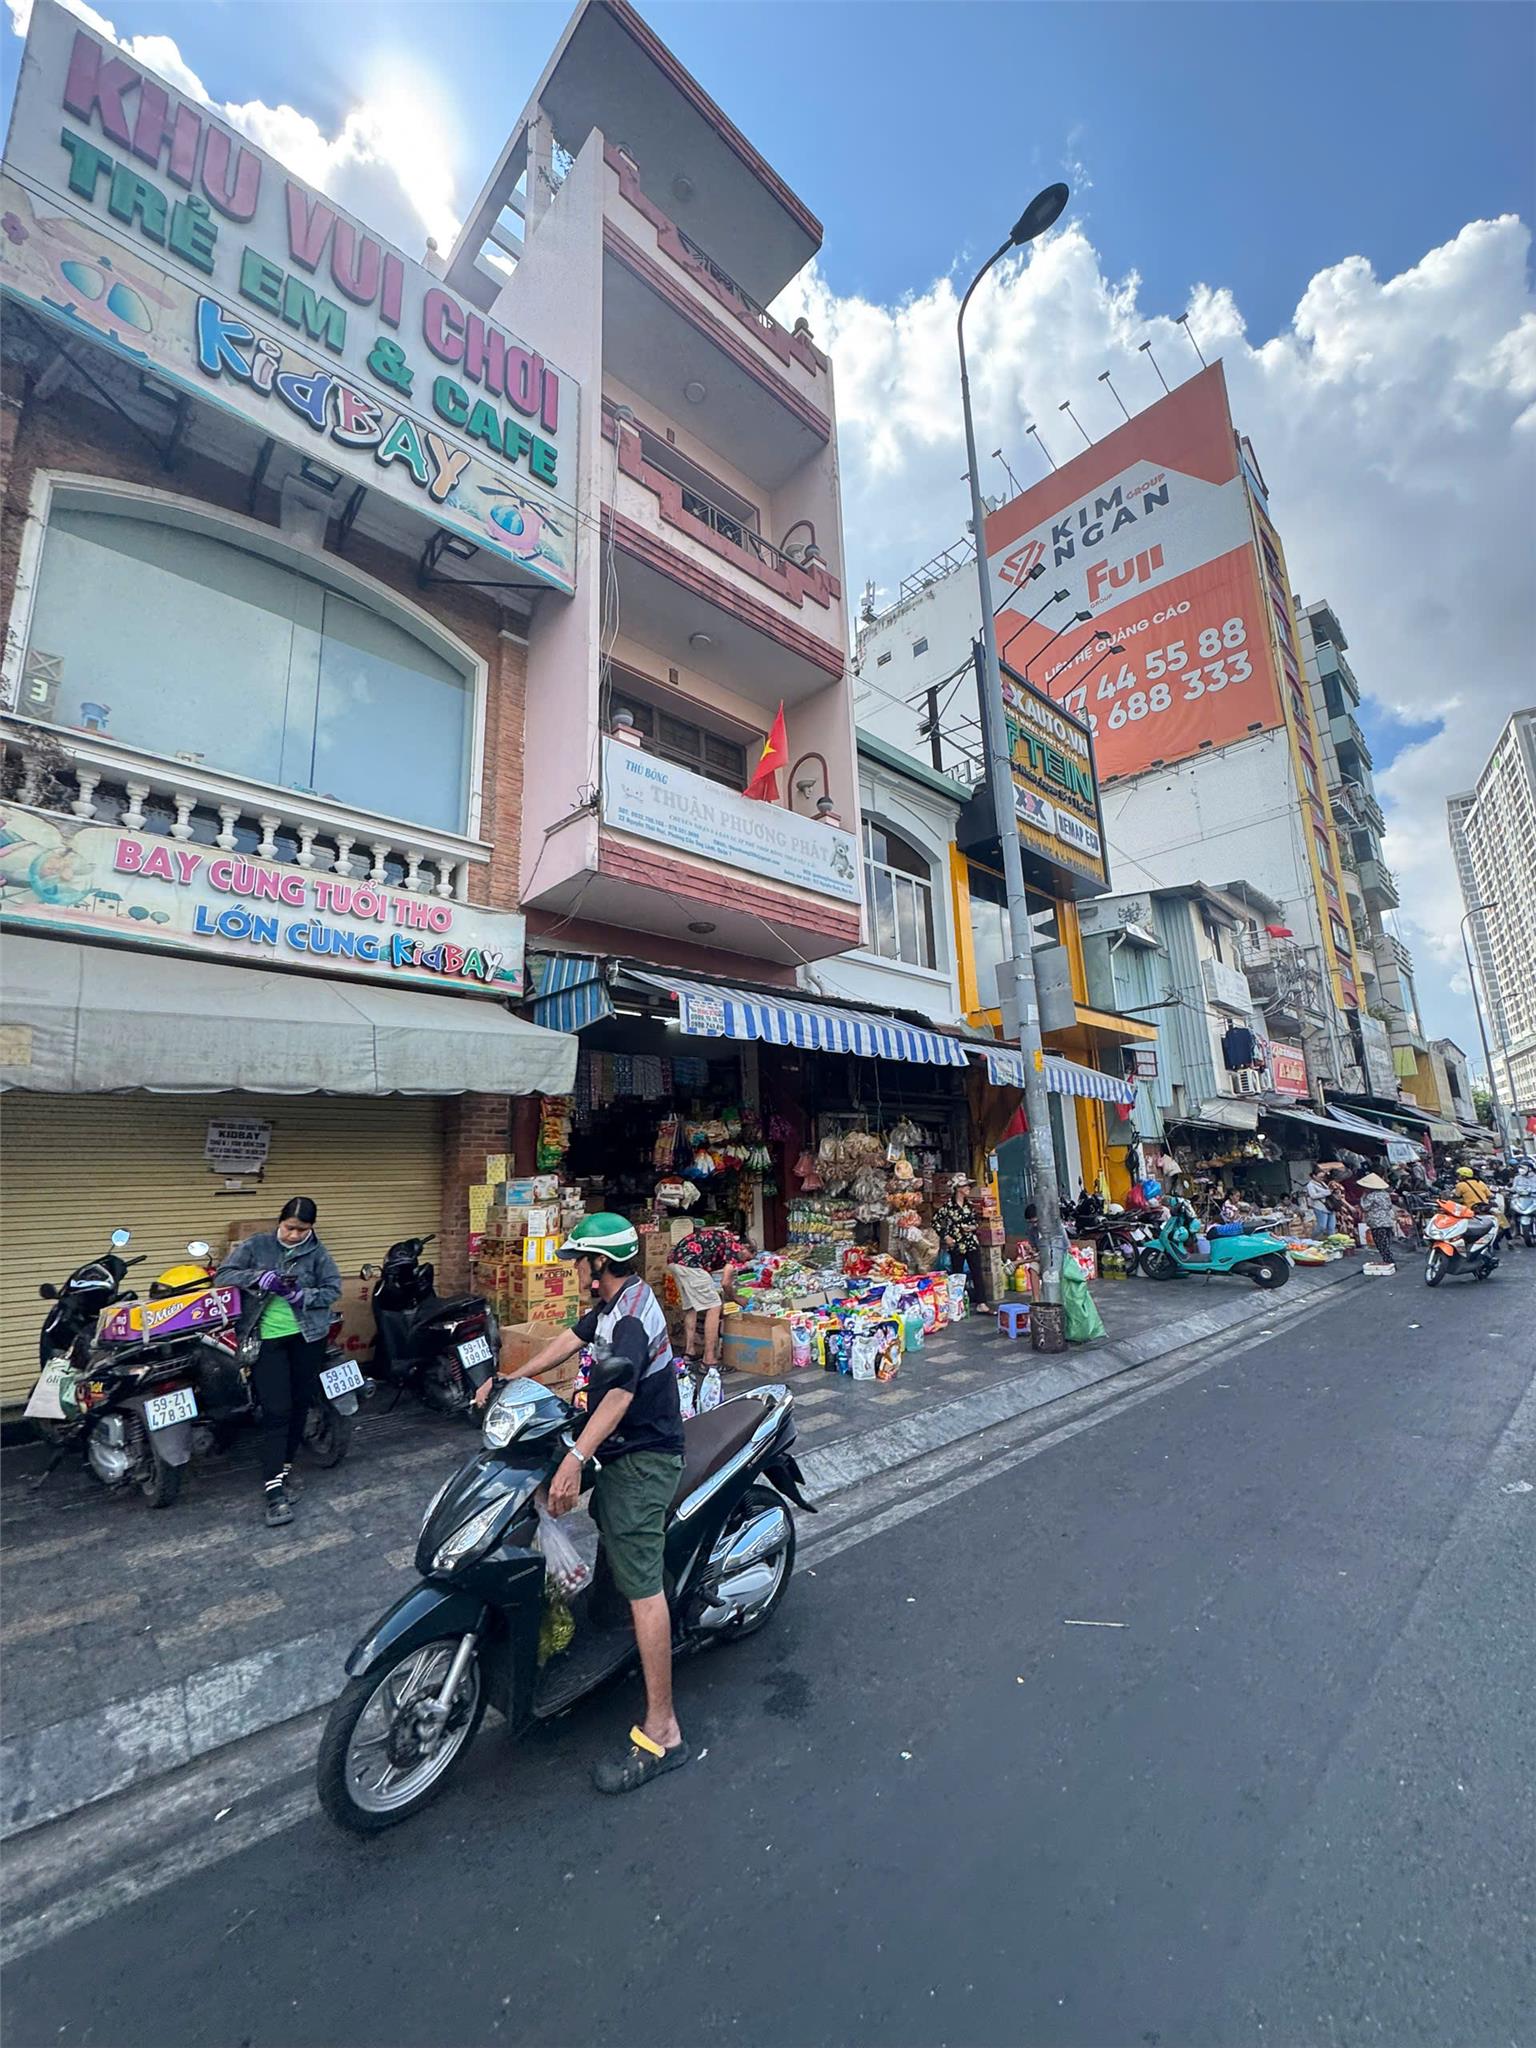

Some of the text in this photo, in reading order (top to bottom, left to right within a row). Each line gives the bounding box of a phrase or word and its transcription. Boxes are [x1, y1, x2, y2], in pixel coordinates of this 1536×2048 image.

[64, 30, 559, 434] KHU VUI CHƠI
[60, 127, 559, 487] TRẺ EM & CAFE
[1052, 473, 1166, 545] KIM GROUP
[1055, 483, 1169, 568] NGAN
[1095, 616, 1150, 652] QUẢNG
[1097, 663, 1137, 701] 44
[1145, 640, 1188, 680] 55
[1199, 617, 1247, 658] 88
[1107, 682, 1172, 730] 688
[1181, 650, 1253, 701] 333
[651, 785, 714, 825] THUẬN
[720, 811, 787, 847] PHƯƠNG
[790, 836, 830, 862] PHÁT
[114, 838, 454, 935] BAY CÙNG TUỔI THƠ
[193, 902, 280, 946] LỚN
[286, 919, 380, 963] CÙNG
[218, 1130, 260, 1140] KIDBAY
[326, 1364, 354, 1383] 59-T1
[462, 1338, 487, 1355] 59-TA
[153, 1391, 188, 1413] 59-Z1
[326, 1374, 362, 1396] 183.08
